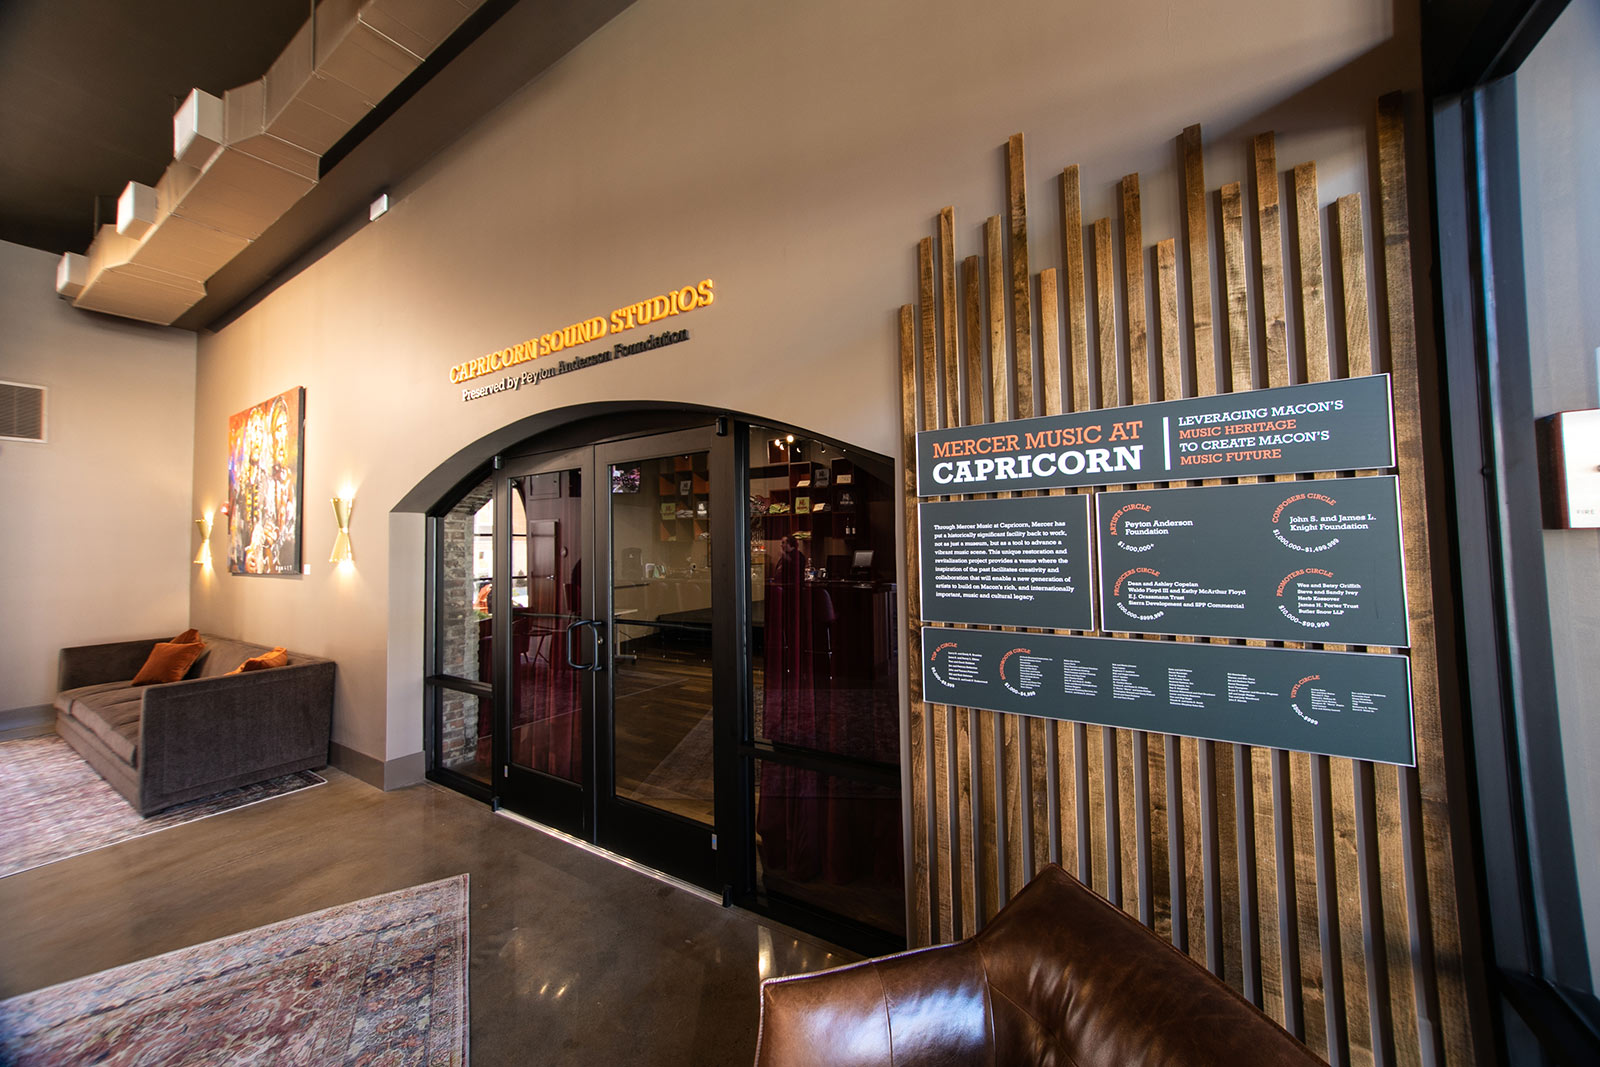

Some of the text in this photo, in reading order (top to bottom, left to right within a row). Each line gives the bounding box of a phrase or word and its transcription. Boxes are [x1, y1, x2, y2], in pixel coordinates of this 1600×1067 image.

[449, 279, 714, 384] CAPRICORN SOUND STUDIOS
[462, 328, 690, 401] Preserved by Peyton Anderson Foundation
[1178, 400, 1344, 426] LEVERAGING MACON'S
[933, 421, 1143, 459] MERCER MUSIC AT
[1179, 419, 1297, 440] MUSIC HERITAGE
[1180, 430, 1330, 452] TO CREATE MACON'S
[932, 445, 1144, 484] CAPRICORN
[1180, 449, 1282, 466] MUSIC FUTURE
[1110, 504, 1152, 536] ARTISTS CIRCLE
[1272, 493, 1336, 523] COMPOSERS CIRCLE
[1114, 568, 1160, 596] PRODUCERS CIRCLE
[1276, 568, 1334, 597] PROMOTERS CIRCLE
